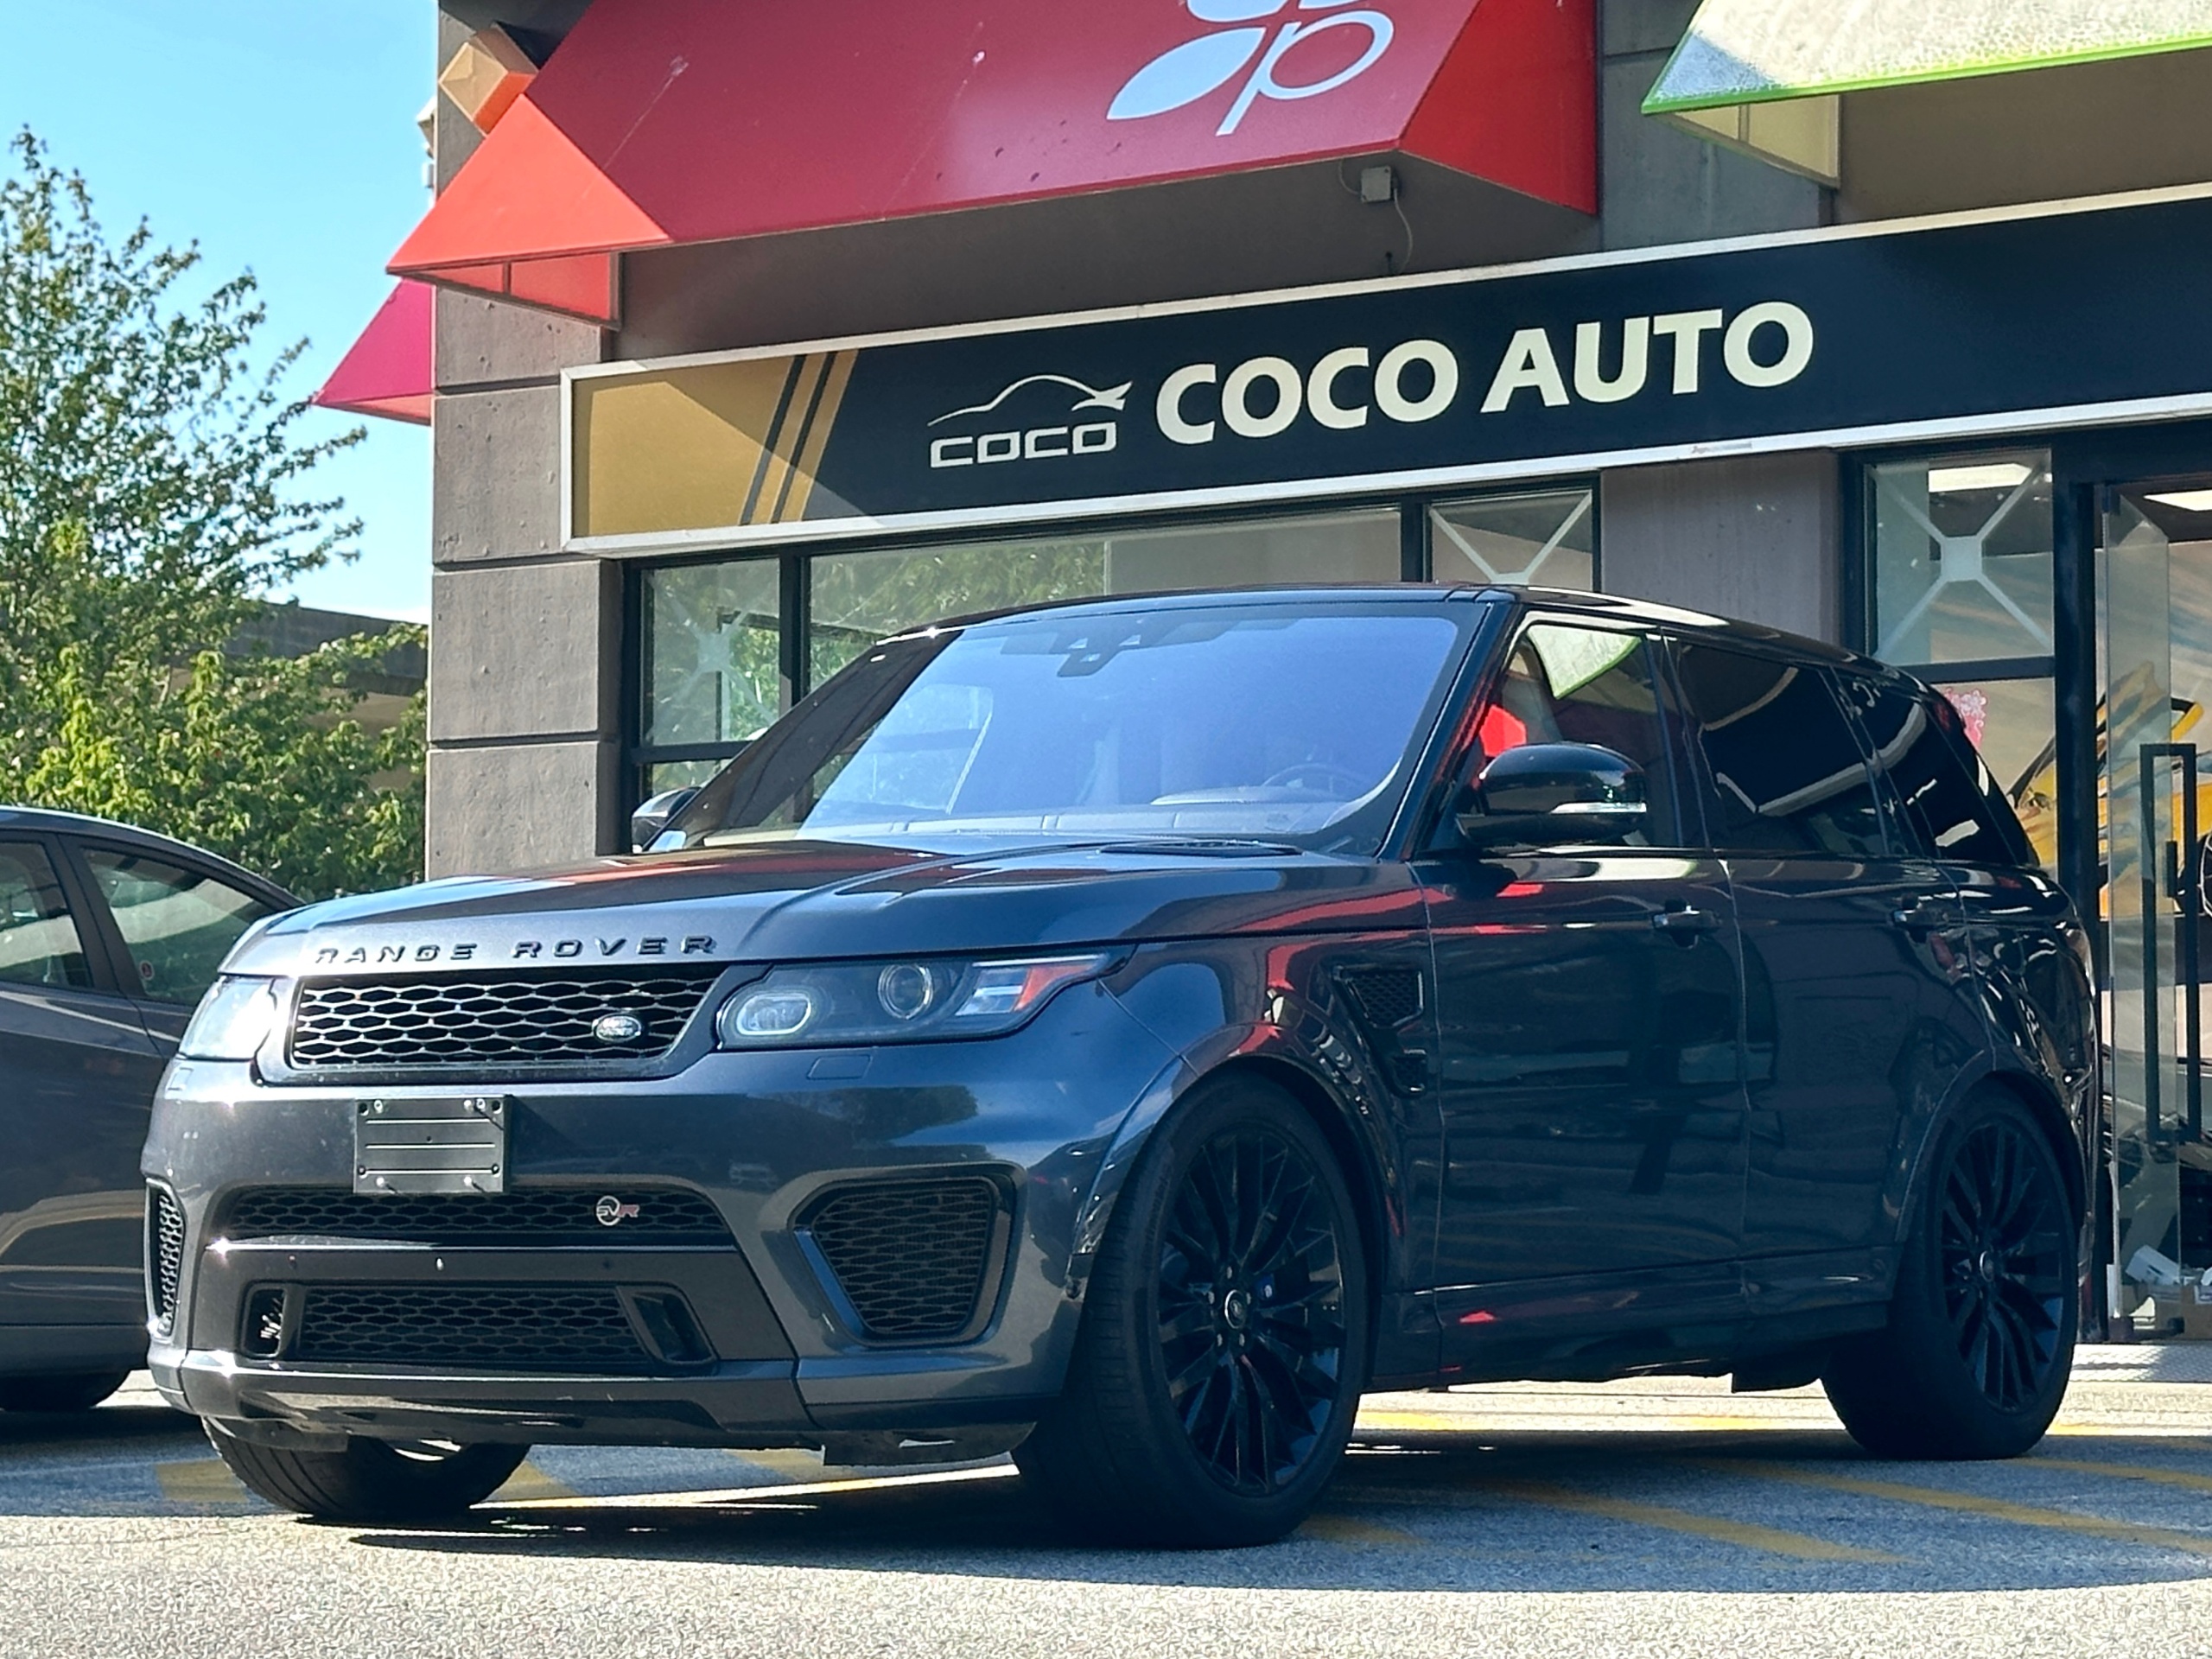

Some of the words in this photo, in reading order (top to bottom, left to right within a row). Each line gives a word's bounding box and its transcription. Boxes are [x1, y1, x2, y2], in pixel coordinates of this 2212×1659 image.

[1156, 340, 1459, 445] COCO
[1480, 302, 1814, 413] AUTO
[930, 422, 1117, 468] COCO
[315, 943, 477, 963] RANGE
[512, 935, 716, 958] ROVER
